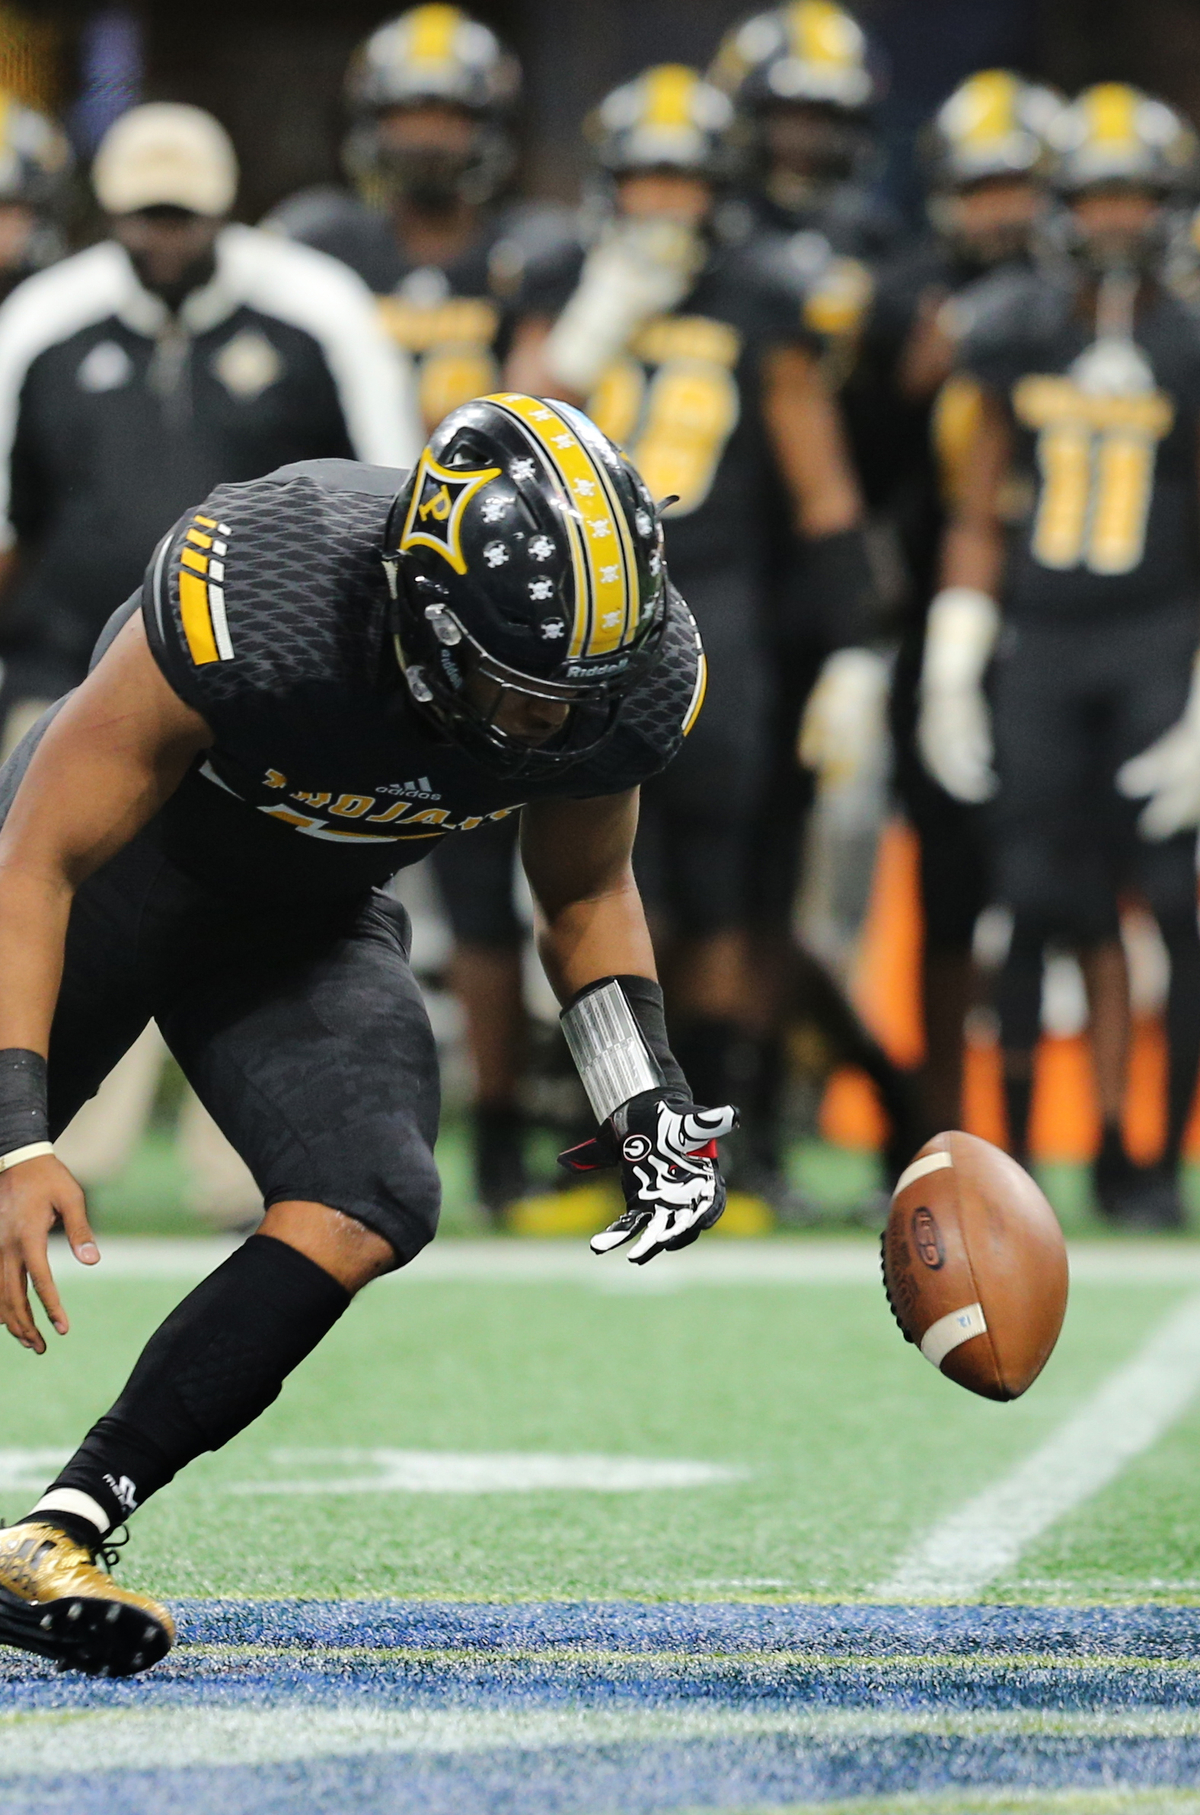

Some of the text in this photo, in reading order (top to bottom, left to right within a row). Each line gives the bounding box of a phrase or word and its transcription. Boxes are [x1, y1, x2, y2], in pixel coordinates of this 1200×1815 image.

[419, 484, 451, 522] P
[1029, 422, 1158, 577] 11
[375, 786, 442, 801] adidas
